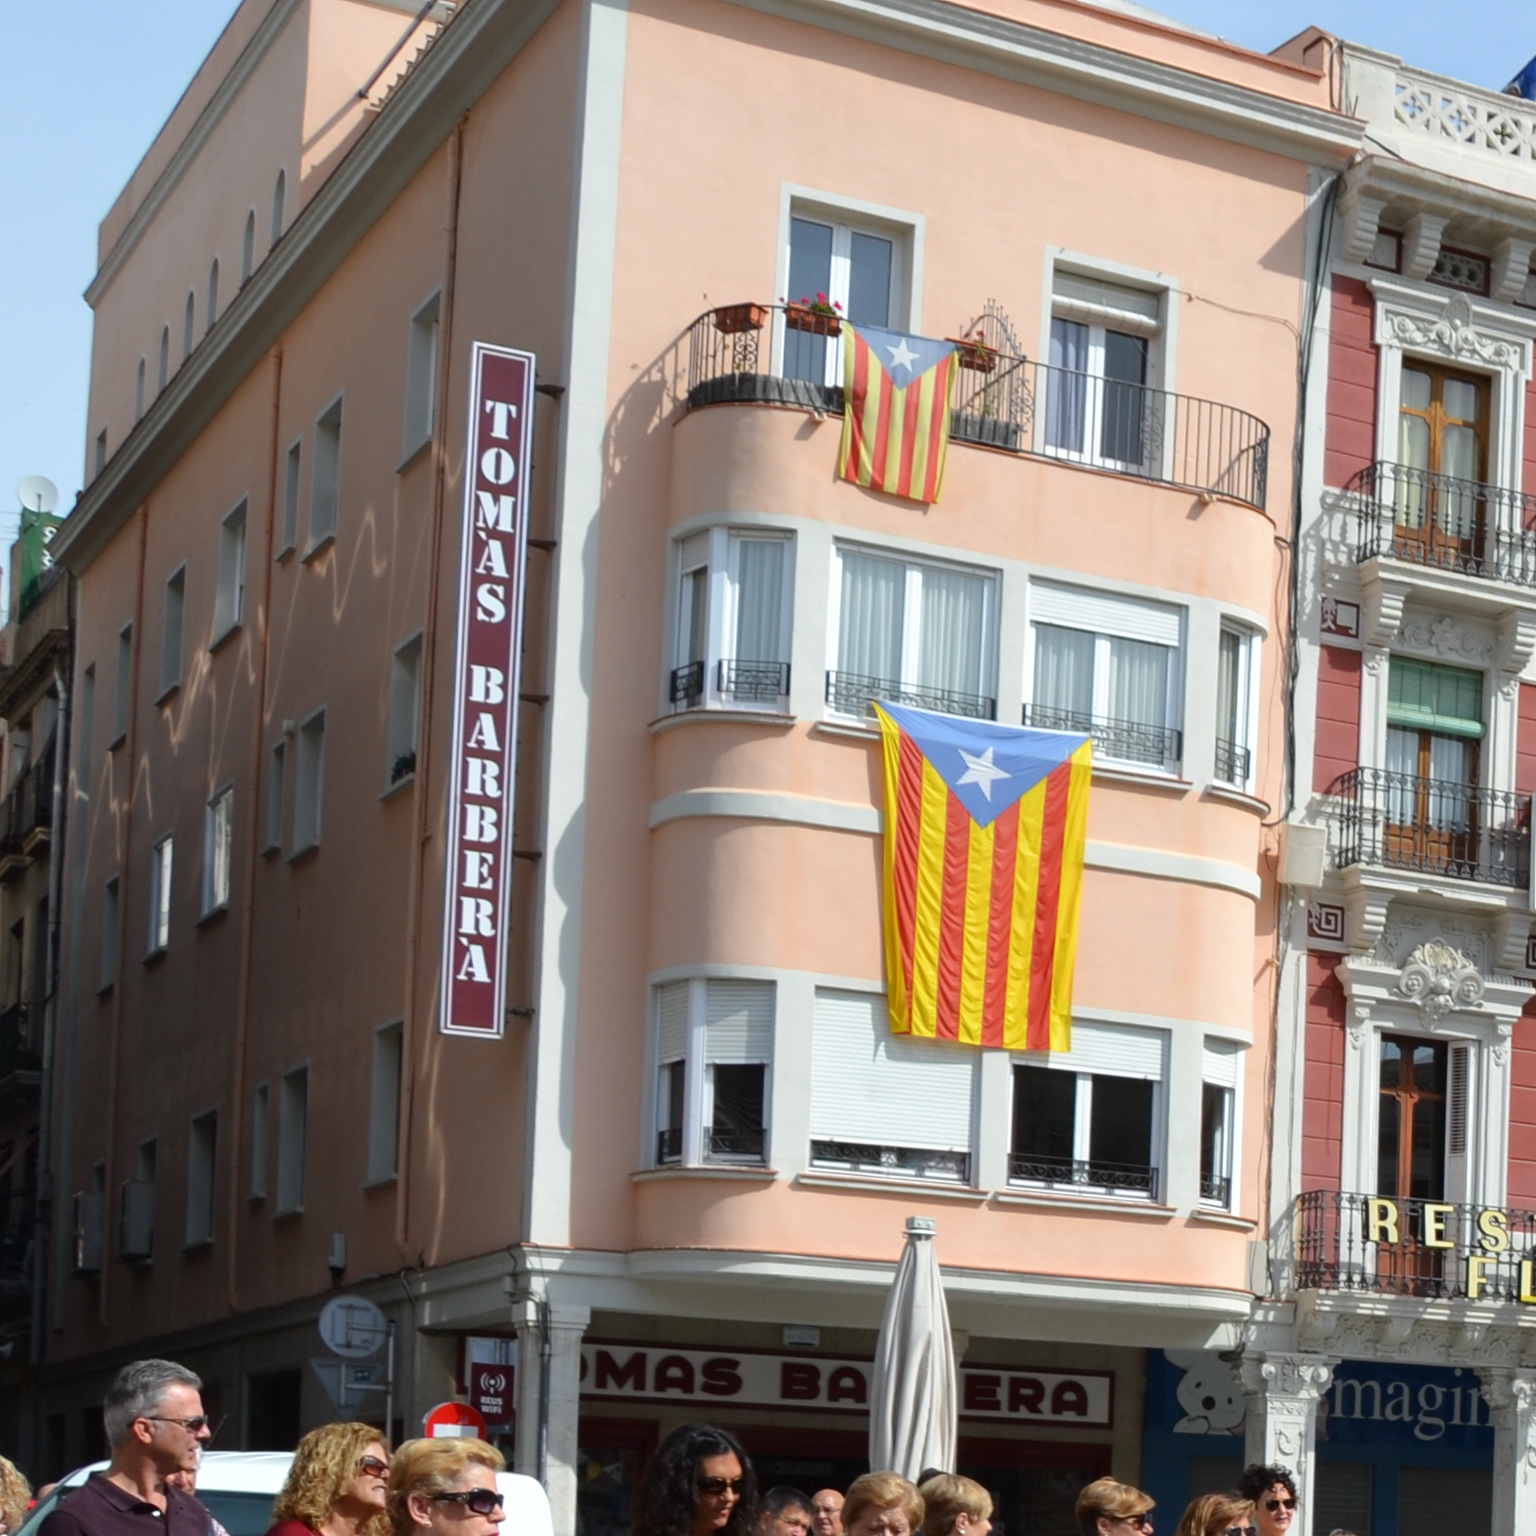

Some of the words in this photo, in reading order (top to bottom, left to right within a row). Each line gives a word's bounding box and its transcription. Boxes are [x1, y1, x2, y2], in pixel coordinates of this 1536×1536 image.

[473, 399, 518, 624] TOMÀS
[456, 664, 505, 984] BARBERÀ
[780, 1362, 1089, 1417] BAERA
